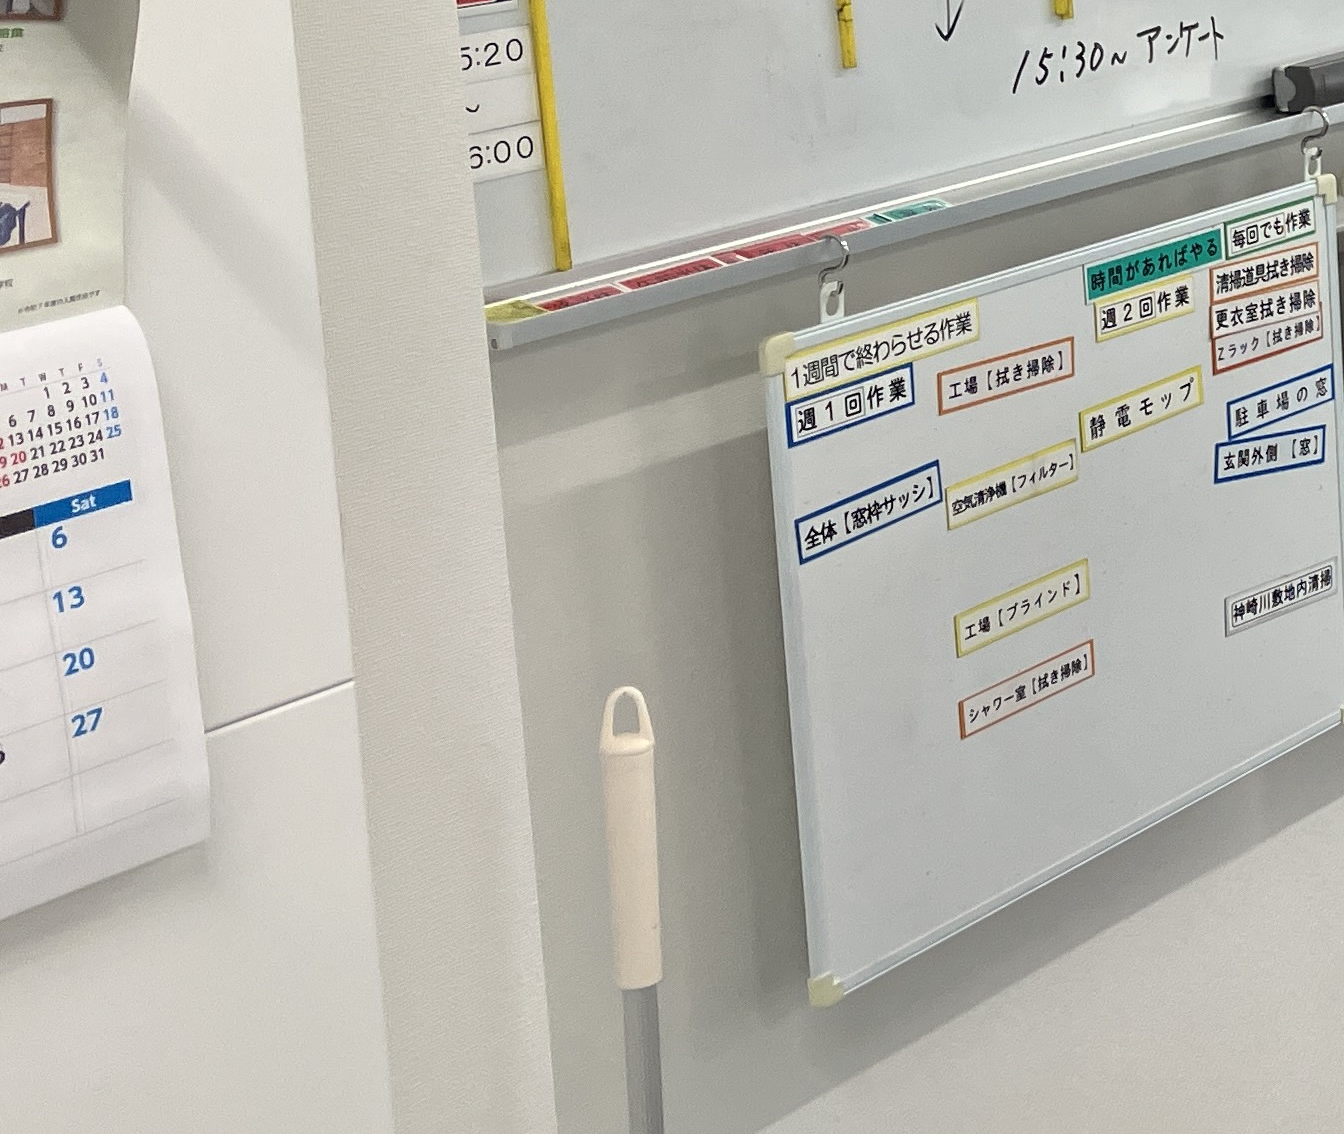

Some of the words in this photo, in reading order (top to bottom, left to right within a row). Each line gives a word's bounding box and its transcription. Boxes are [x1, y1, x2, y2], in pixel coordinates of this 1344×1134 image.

[1136, 16, 1224, 63] アンケート
[1232, 209, 1311, 249] 毎回でも作業
[1091, 238, 1218, 291] 時間があればやる
[1216, 251, 1314, 294] 清掃道具拭き掃除
[1101, 286, 1189, 330] 週2回作業
[1216, 289, 1316, 330] 更衣室拭き掃除
[791, 314, 973, 389] 1週間で終わらせる作業
[62, 382, 71, 394] 2
[81, 377, 90, 389] 3
[100, 372, 108, 384] 4
[1235, 377, 1328, 427] 駐車場の窓
[8, 415, 17, 428] 6
[27, 409, 36, 422] 7
[47, 404, 56, 417] 8
[66, 399, 75, 412] 9
[82, 393, 97, 408] 10
[100, 389, 115, 403] 11
[8, 432, 24, 447] 13
[28, 426, 43, 442] 14
[47, 421, 63, 436] 15
[66, 416, 82, 431] 16
[85, 411, 100, 426] 17
[104, 406, 119, 421] 18
[798, 378, 906, 434] 週1回作業
[1089, 377, 1194, 440] 静電モップ
[10, 450, 27, 466] 20
[30, 445, 45, 461] 21
[50, 440, 66, 456] 22
[68, 434, 84, 450] 23
[87, 429, 103, 445] 24
[106, 424, 122, 439] 25
[13, 468, 29, 484] 27
[33, 463, 49, 479] 28
[52, 458, 68, 473] 29
[71, 452, 87, 468] 30
[89, 447, 105, 463] 31
[70, 494, 97, 514] Sat
[51, 526, 68, 549] 6
[52, 585, 86, 613] 13
[62, 646, 95, 677] 20
[71, 707, 103, 739] 27
